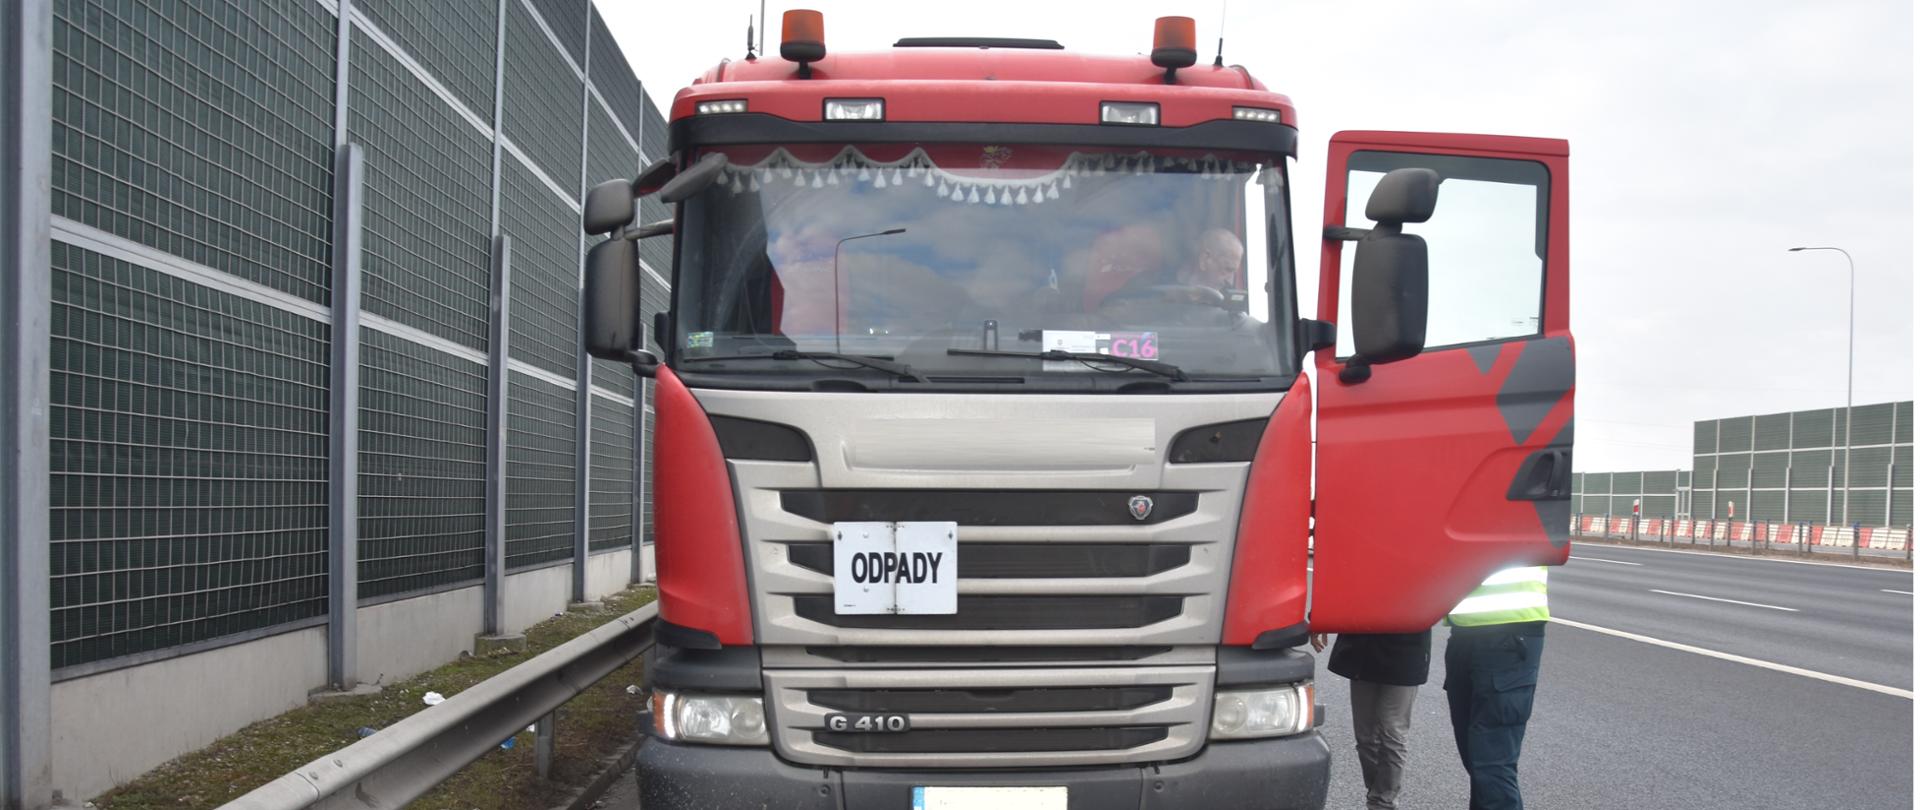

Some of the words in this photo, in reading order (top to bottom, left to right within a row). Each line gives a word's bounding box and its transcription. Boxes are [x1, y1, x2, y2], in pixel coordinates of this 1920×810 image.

[1112, 338, 1155, 358] C16
[851, 551, 943, 584] ODPADY
[829, 715, 847, 731] G
[854, 715, 905, 731] 410
